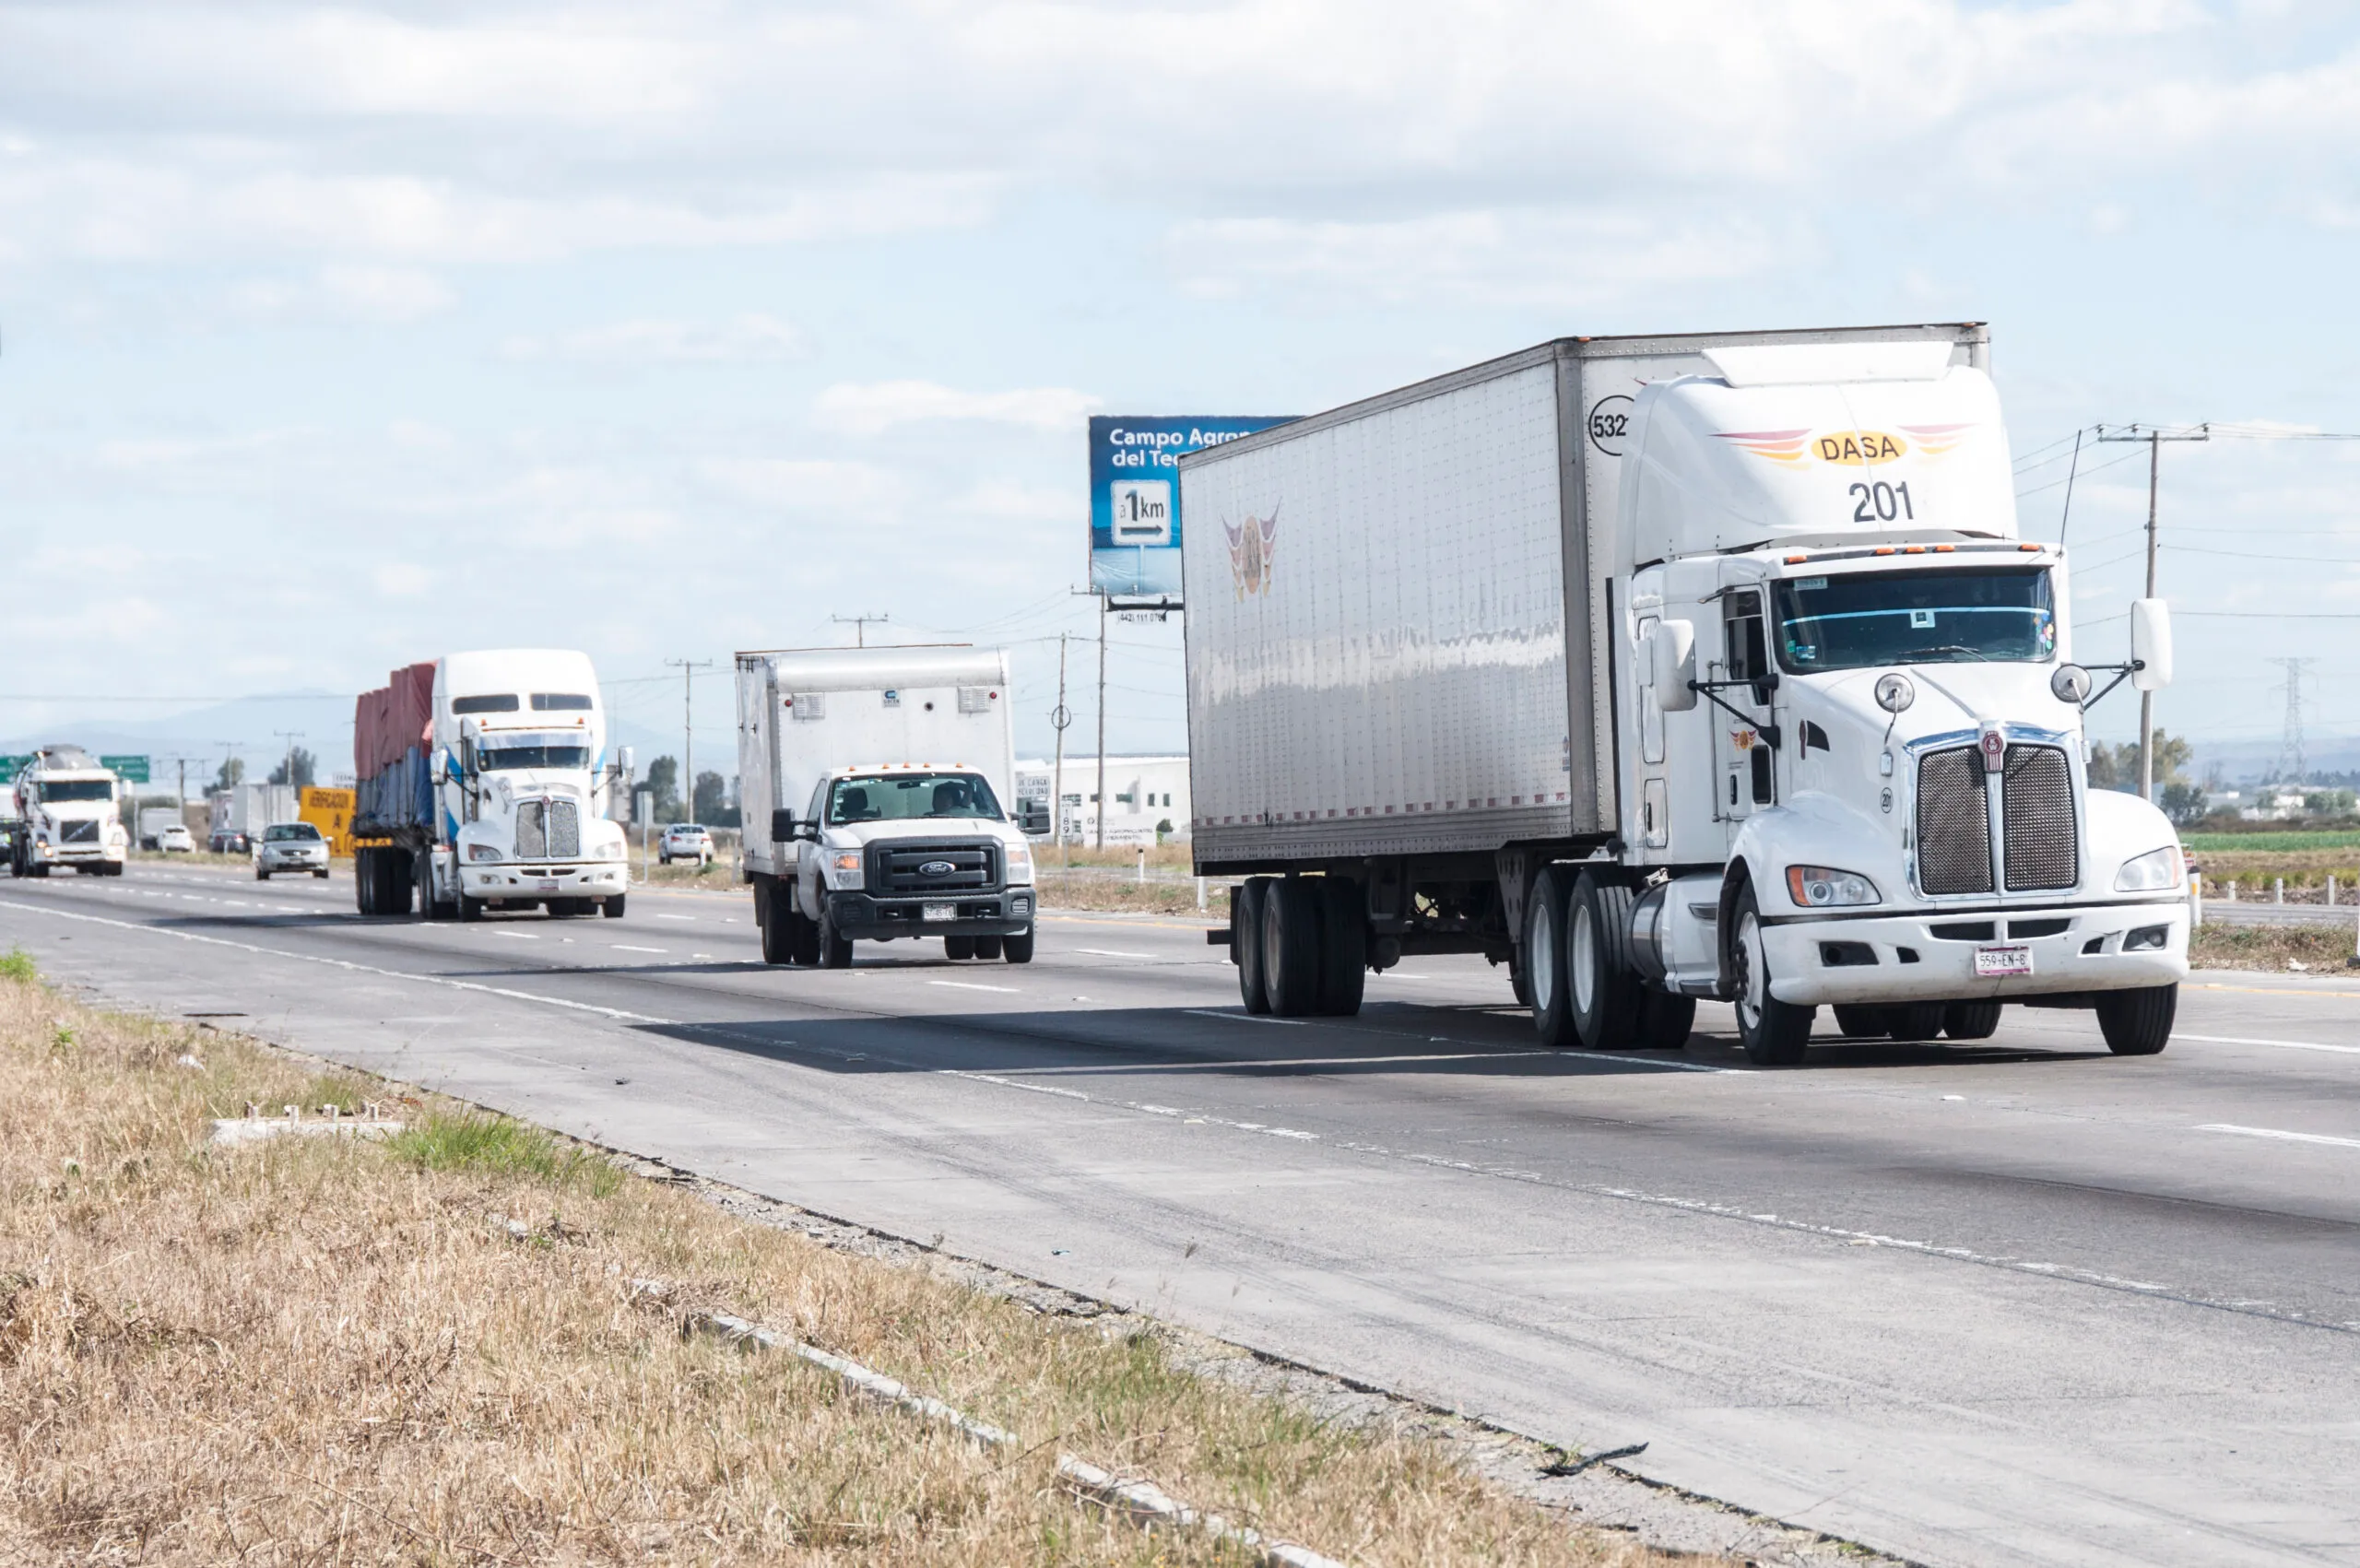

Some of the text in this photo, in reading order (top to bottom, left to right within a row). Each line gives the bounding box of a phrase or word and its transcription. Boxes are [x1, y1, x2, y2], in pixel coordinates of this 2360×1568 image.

[1594, 414, 1629, 438] 532
[1109, 428, 1184, 449] Campo
[1821, 436, 1900, 460] DASA
[1112, 449, 1145, 466] del
[1120, 489, 1164, 522] a 1 km
[1849, 481, 1914, 523] 201
[927, 863, 947, 872] Ford
